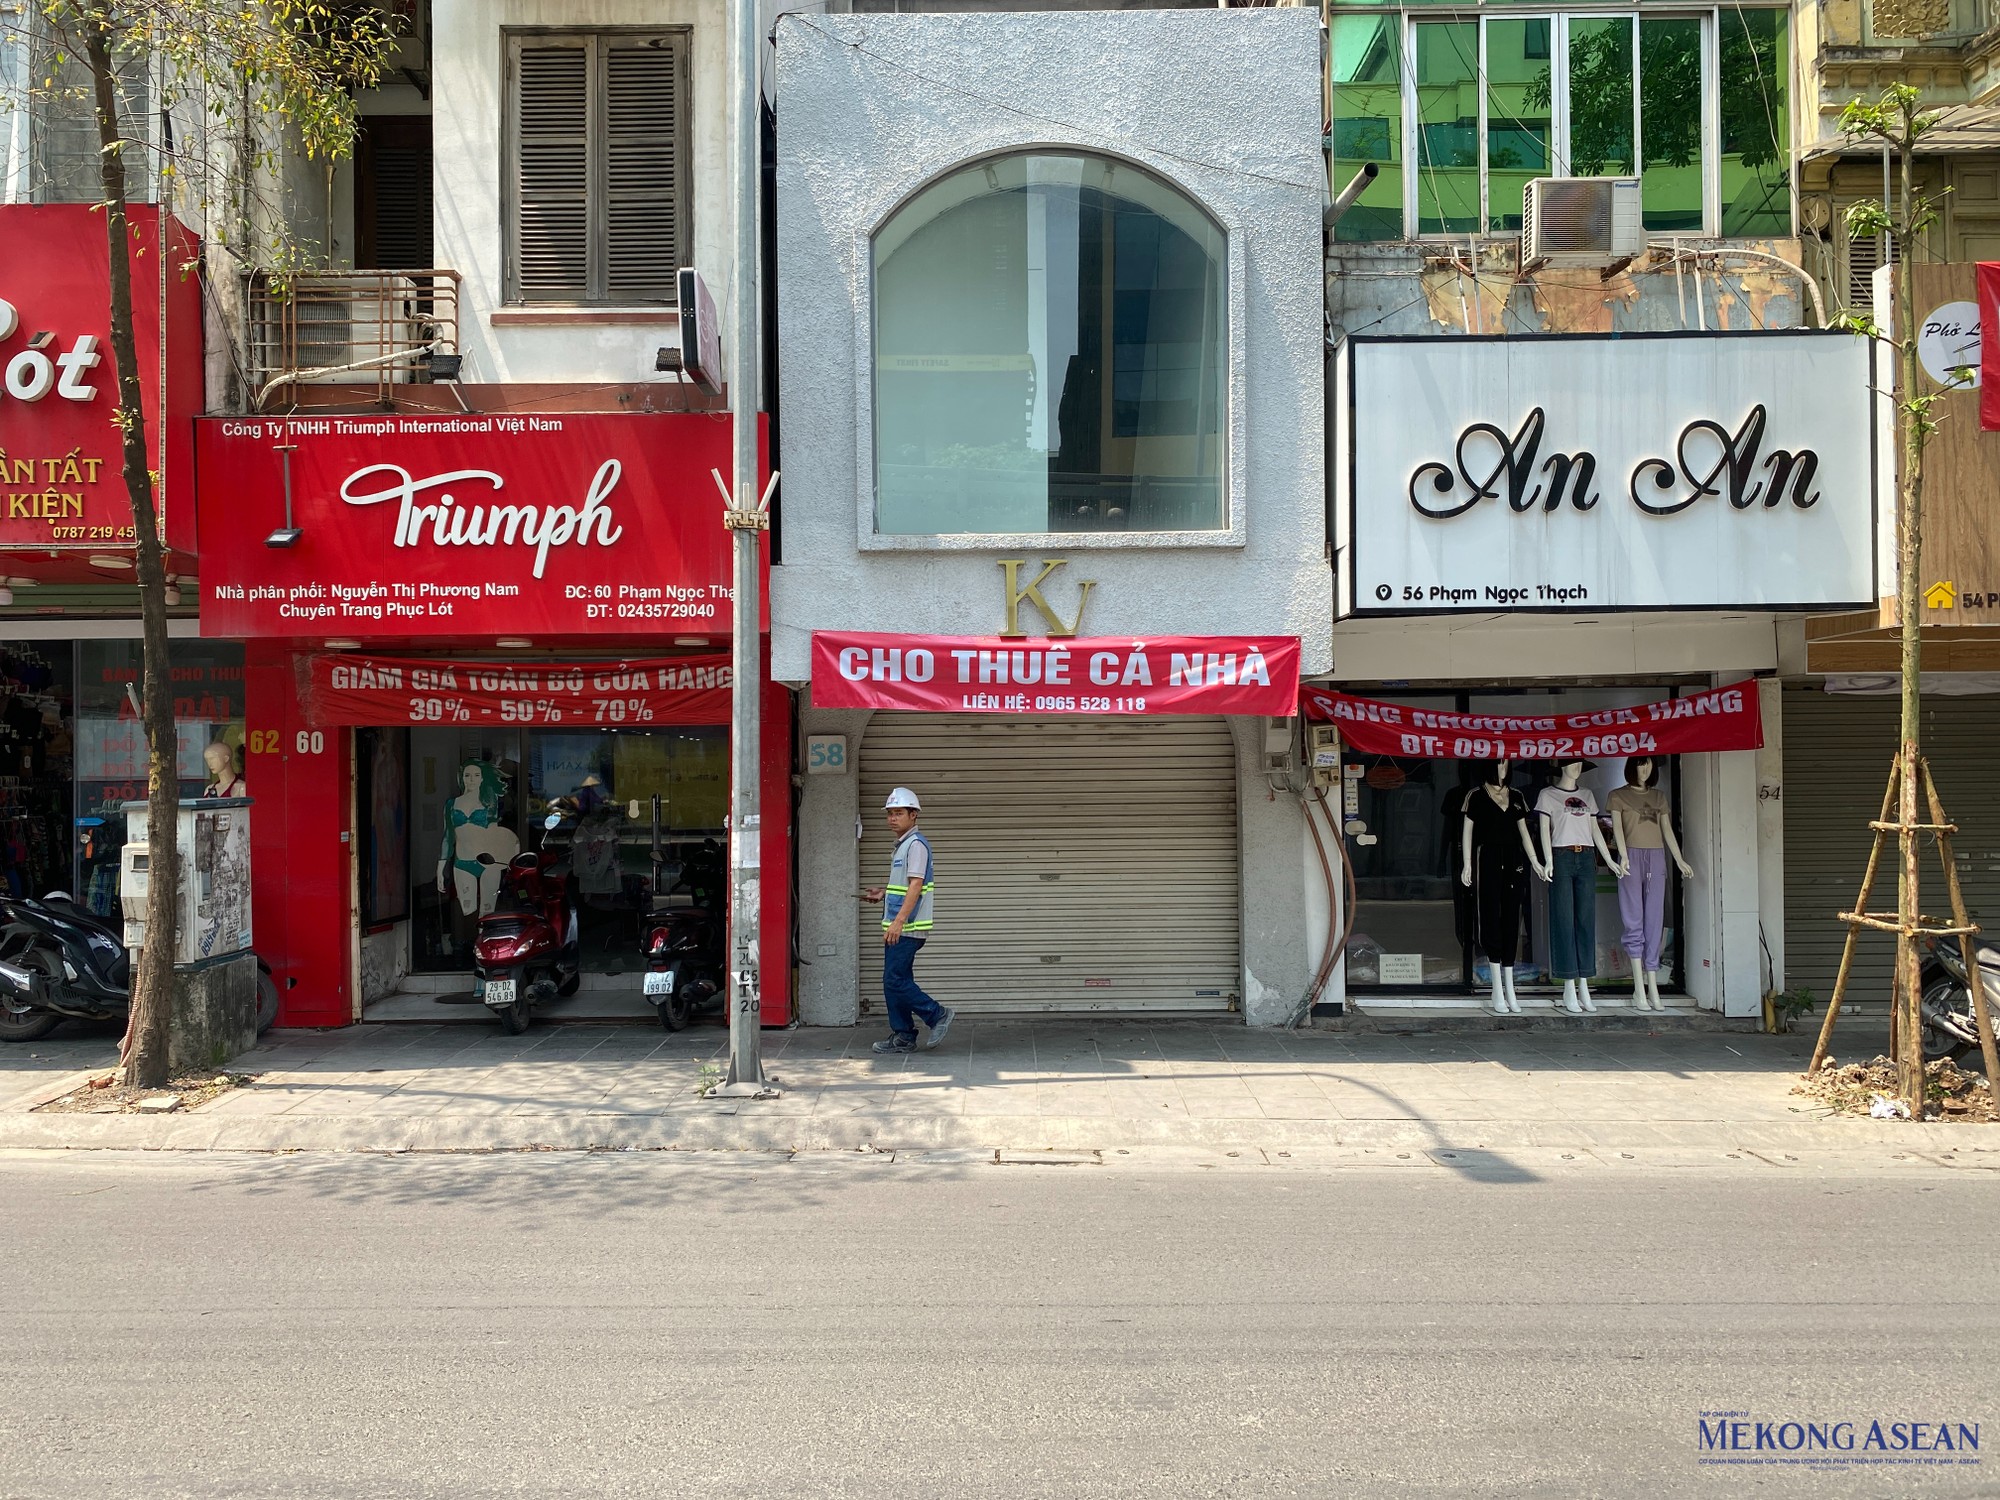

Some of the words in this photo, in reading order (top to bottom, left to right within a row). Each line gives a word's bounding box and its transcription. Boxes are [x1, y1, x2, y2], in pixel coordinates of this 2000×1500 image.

[1925, 321, 1961, 338] Phở
[0, 331, 101, 401] ót
[222, 423, 262, 438] Công
[266, 423, 283, 438] Ty
[288, 421, 330, 435] TNHH
[334, 421, 395, 437] Triumph
[399, 418, 492, 433] International
[496, 418, 525, 434] Việt
[529, 418, 563, 431] Nam
[42, 447, 103, 484] TẤT
[1408, 405, 1599, 519] An
[1629, 403, 1820, 517] An
[9, 487, 84, 524] KIỆN
[339, 458, 623, 579] Triumph
[53, 526, 84, 539] 0787
[89, 526, 113, 539] 219
[117, 526, 135, 539] 45
[215, 583, 245, 599] Nhà
[249, 584, 286, 601] phân
[290, 581, 327, 601] phối:
[331, 581, 388, 601] Nguyễn
[392, 583, 415, 599] Thị
[419, 583, 481, 600] Phương
[485, 582, 519, 596] Nam
[565, 584, 592, 599] ĐC:
[594, 584, 612, 598] 60
[619, 584, 662, 602] Phạm
[666, 584, 705, 602] Ngọc
[708, 584, 735, 602] Thạ
[1402, 585, 1423, 600] 56
[1429, 585, 1477, 604] Phạm
[1485, 585, 1528, 604] Ngọc
[1536, 584, 1587, 603] Thạch
[1963, 593, 1984, 608] 54
[1988, 593, 2000, 608] P
[279, 602, 336, 620] Chuyên
[340, 602, 382, 619] Trang
[386, 602, 424, 619] Phục
[428, 601, 453, 616] Lót
[586, 603, 613, 618] ĐT:
[617, 603, 715, 618] 02435729040
[209, 666, 246, 681] THU
[838, 646, 935, 683] CHO
[950, 643, 1071, 685] THUÊ
[1089, 641, 1153, 686] CẢ
[1169, 645, 1271, 686] NHÀ
[331, 660, 402, 690] GIẢM
[411, 665, 457, 691] GIÁ
[547, 666, 584, 696] BỘ
[593, 663, 650, 692] CỦA
[658, 663, 733, 691] HÀNG
[409, 698, 470, 721] 30%
[500, 698, 561, 722] 50%
[592, 698, 653, 722] 70%
[962, 692, 1000, 709] LIÊN
[1004, 692, 1030, 712] HỆ:
[1035, 696, 1075, 710] 0965
[1080, 696, 1111, 711] 528
[1116, 697, 1145, 711] 118
[1313, 695, 1402, 724] SANG
[250, 730, 279, 754] 62
[296, 731, 324, 754] 60
[1401, 733, 1444, 756] ĐT:
[1453, 731, 1657, 759] 091.662.6694
[810, 743, 844, 767] 58
[1760, 785, 1781, 800] 54
[487, 990, 514, 1003] 546.89
